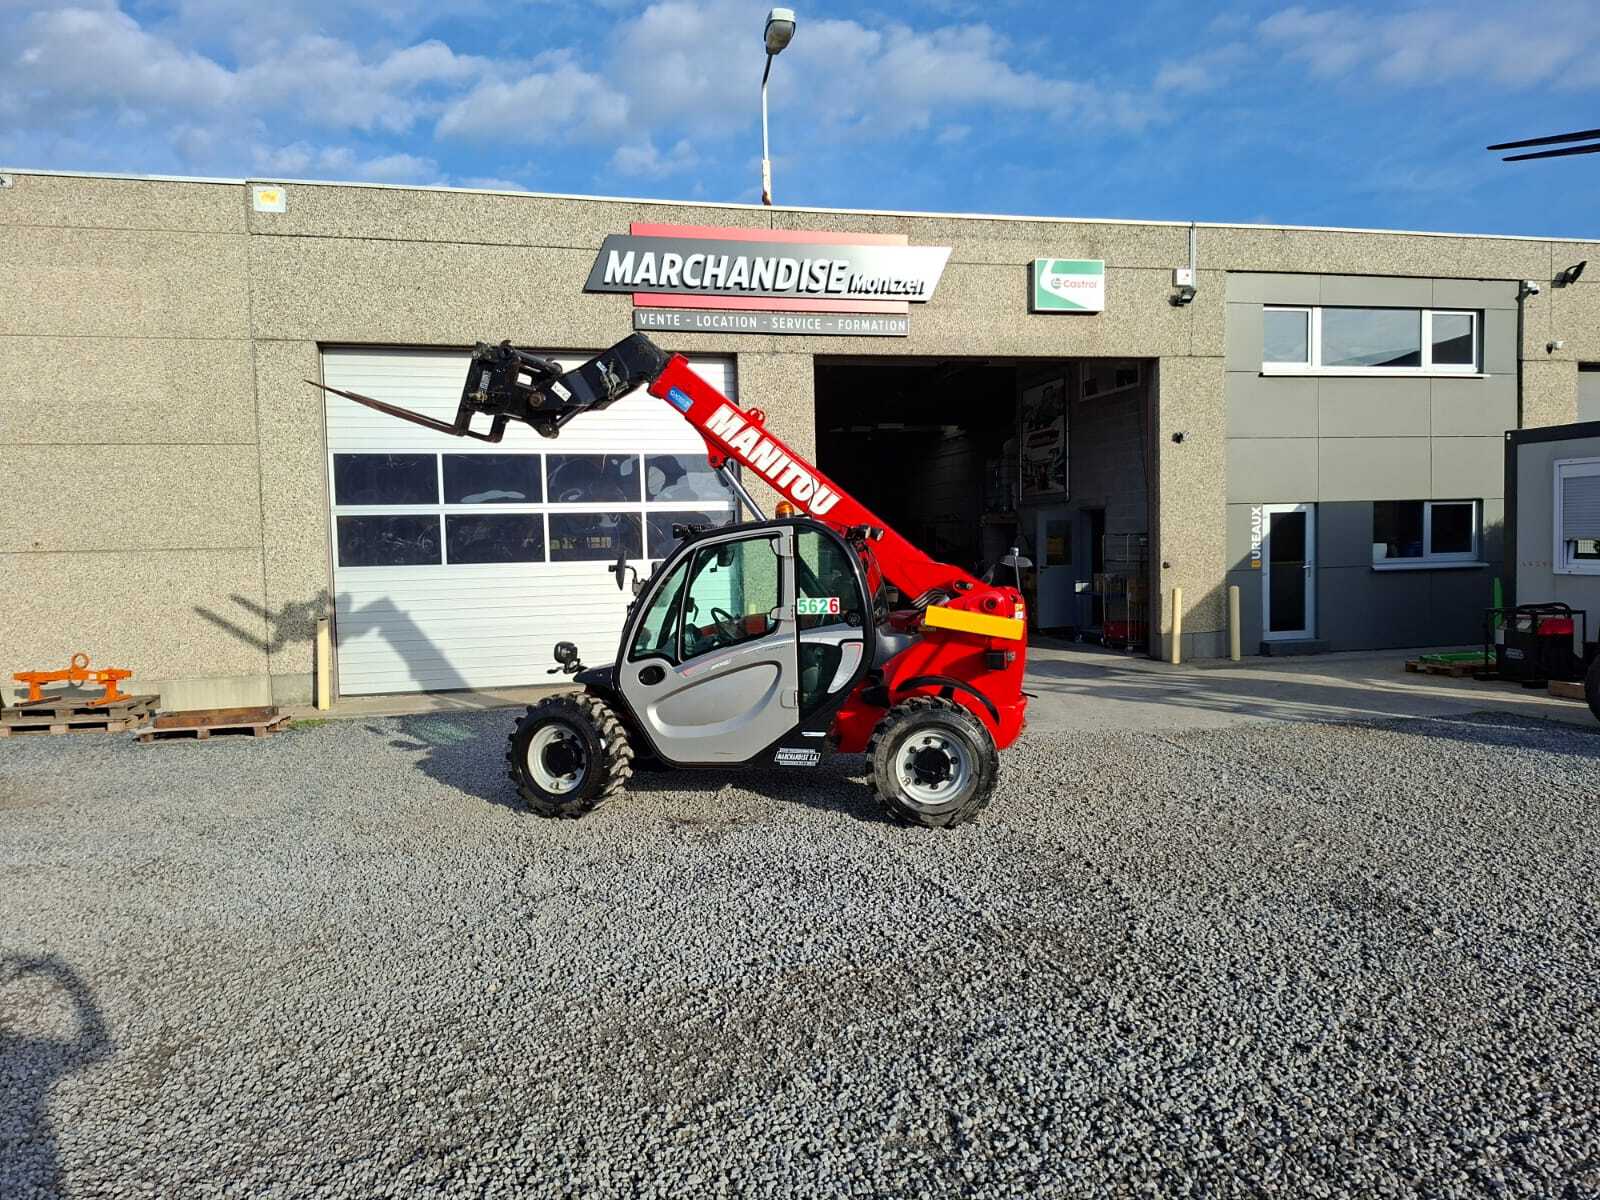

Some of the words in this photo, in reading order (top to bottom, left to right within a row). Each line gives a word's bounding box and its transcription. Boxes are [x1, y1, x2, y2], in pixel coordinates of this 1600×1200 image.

[603, 250, 850, 292] MARCHANDISE
[1063, 279, 1098, 288] Castrol
[639, 313, 681, 327] VENTE
[696, 315, 757, 329] LOCATION
[772, 317, 822, 330] SERVICE
[838, 319, 906, 332] FORMATION
[703, 402, 842, 516] MANITOU
[1251, 506, 1262, 569] BUREAUX
[798, 598, 839, 614] 5626
